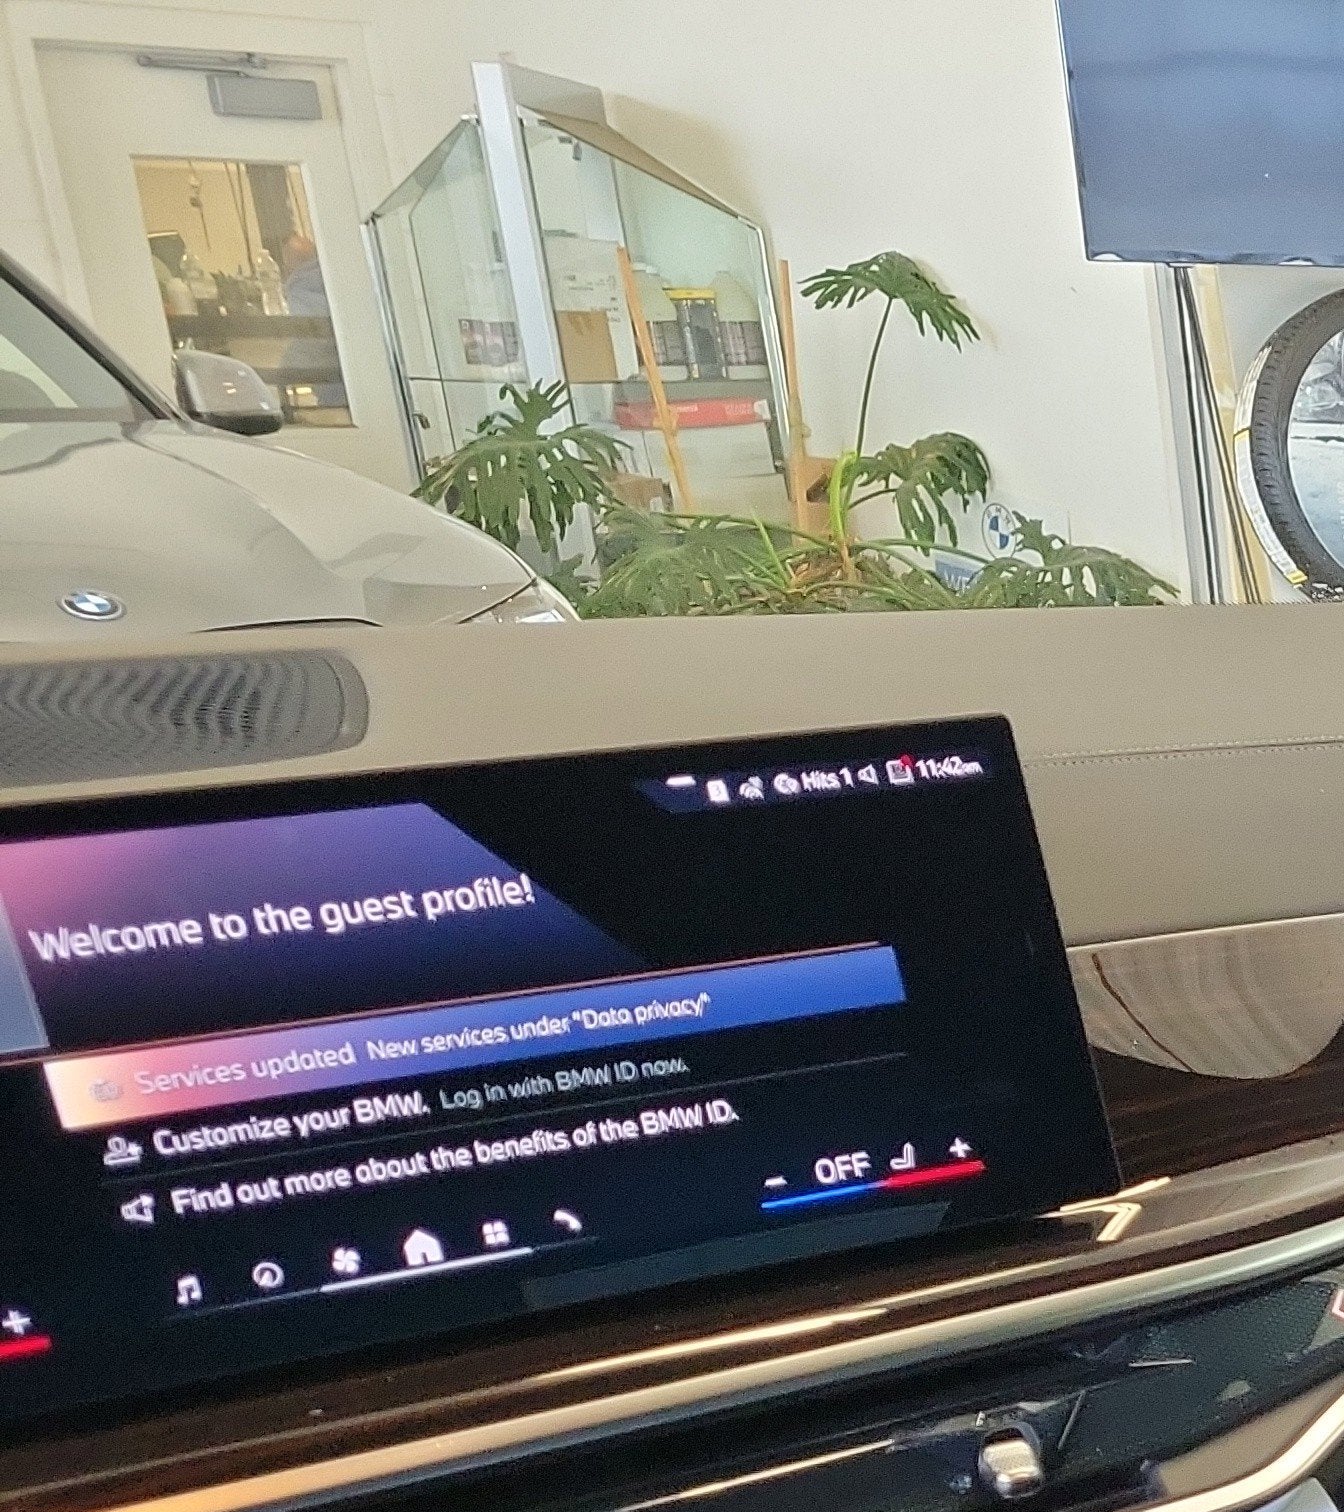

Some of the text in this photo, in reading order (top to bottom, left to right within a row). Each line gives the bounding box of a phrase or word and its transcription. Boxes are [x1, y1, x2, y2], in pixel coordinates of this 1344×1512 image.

[802, 770, 841, 792] Hits
[840, 768, 852, 787] 1
[28, 873, 535, 962] Welcome to the guest profile!
[134, 1062, 247, 1096] Services
[251, 1041, 357, 1081] updated
[366, 1038, 420, 1062] New
[421, 1026, 510, 1054] services
[510, 1014, 572, 1040] under
[152, 1056, 690, 1157] Customize your BMW. Log in with BMW ID now.
[171, 1099, 740, 1217] Find out more about the benefits of the BMW ID.
[815, 1150, 872, 1185] OFF
